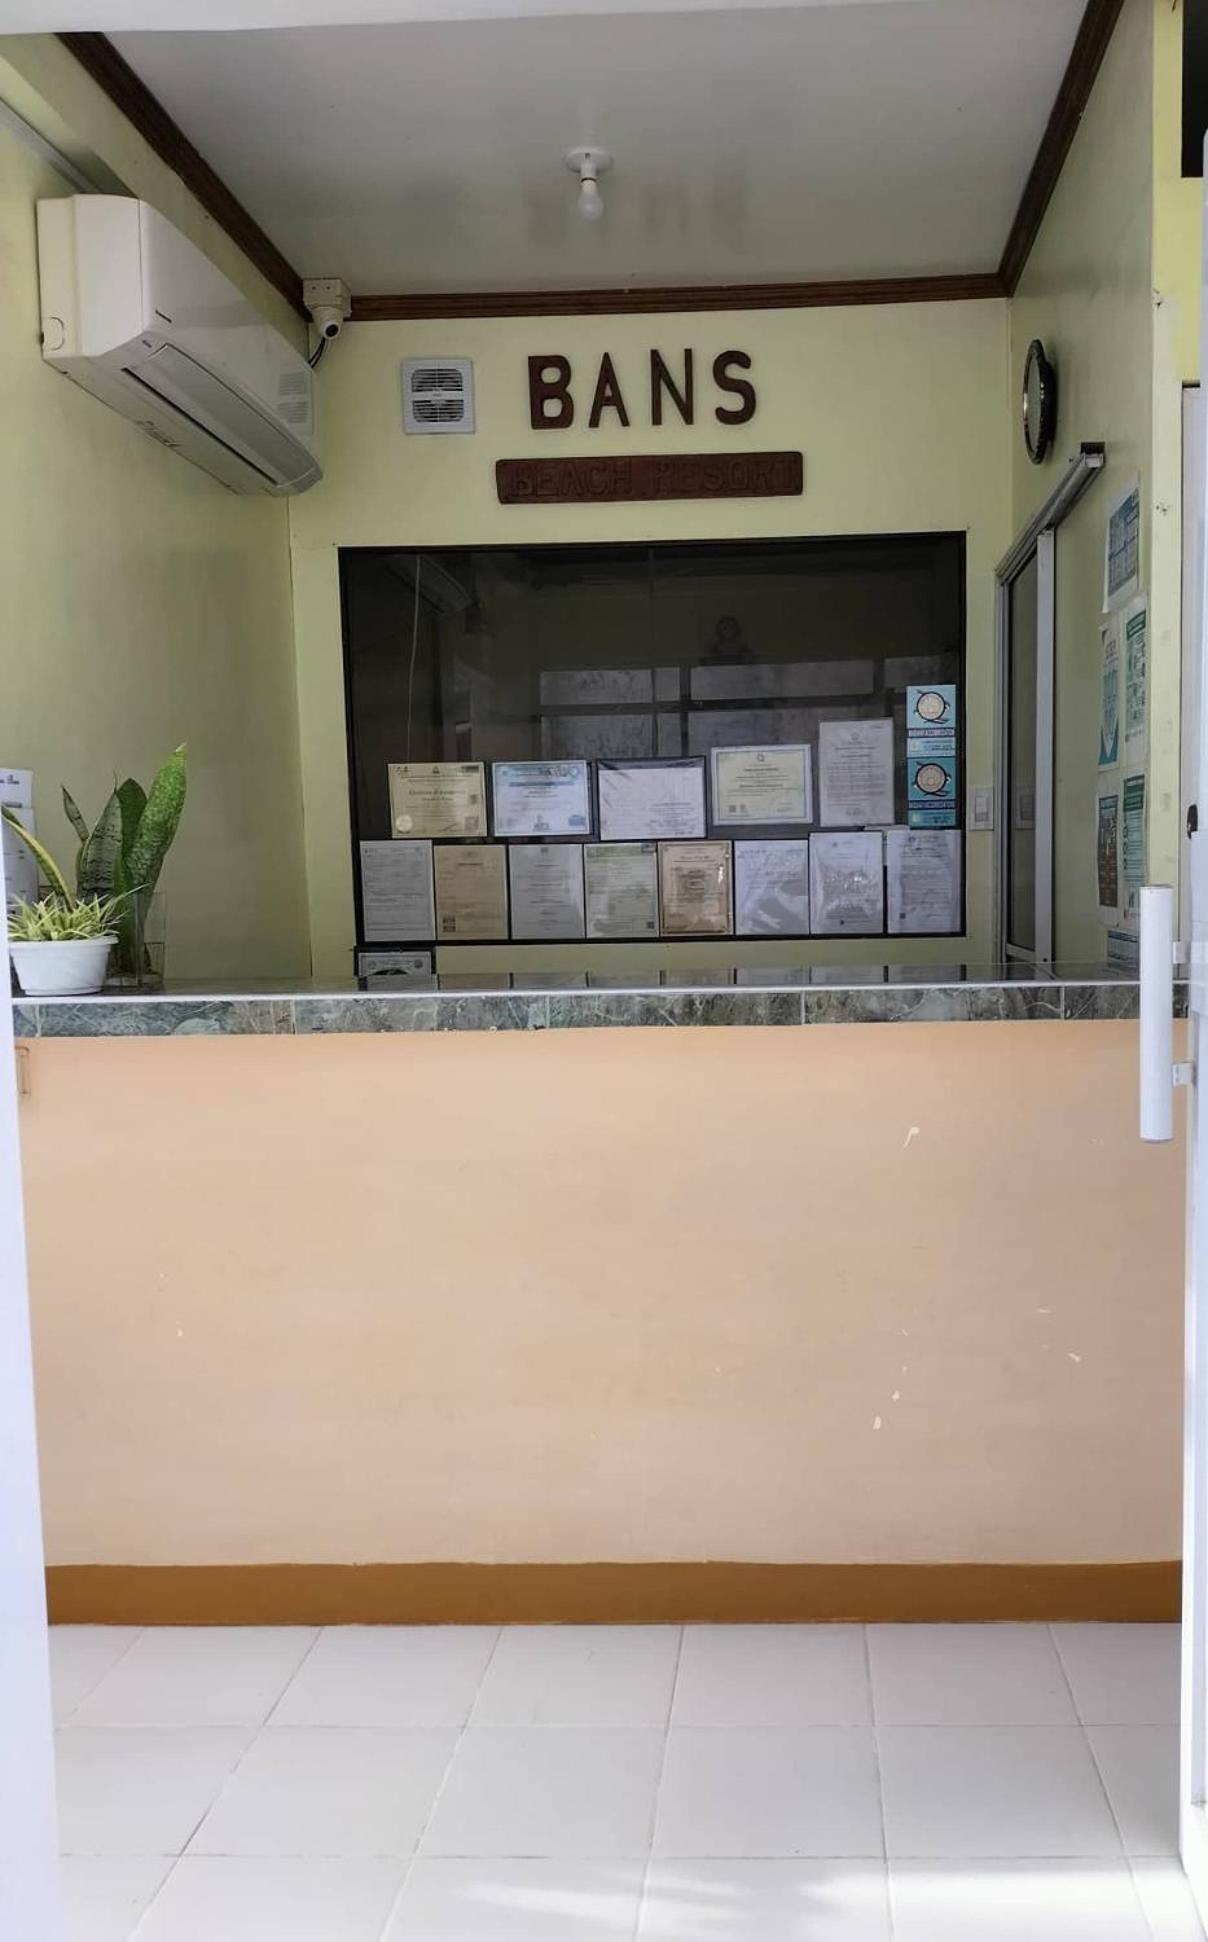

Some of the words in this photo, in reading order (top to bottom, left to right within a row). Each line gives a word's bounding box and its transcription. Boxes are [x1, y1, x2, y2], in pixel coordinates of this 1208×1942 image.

[528, 349, 756, 430] BANS
[514, 459, 632, 498] BEACH
[654, 456, 799, 494] RESORT
